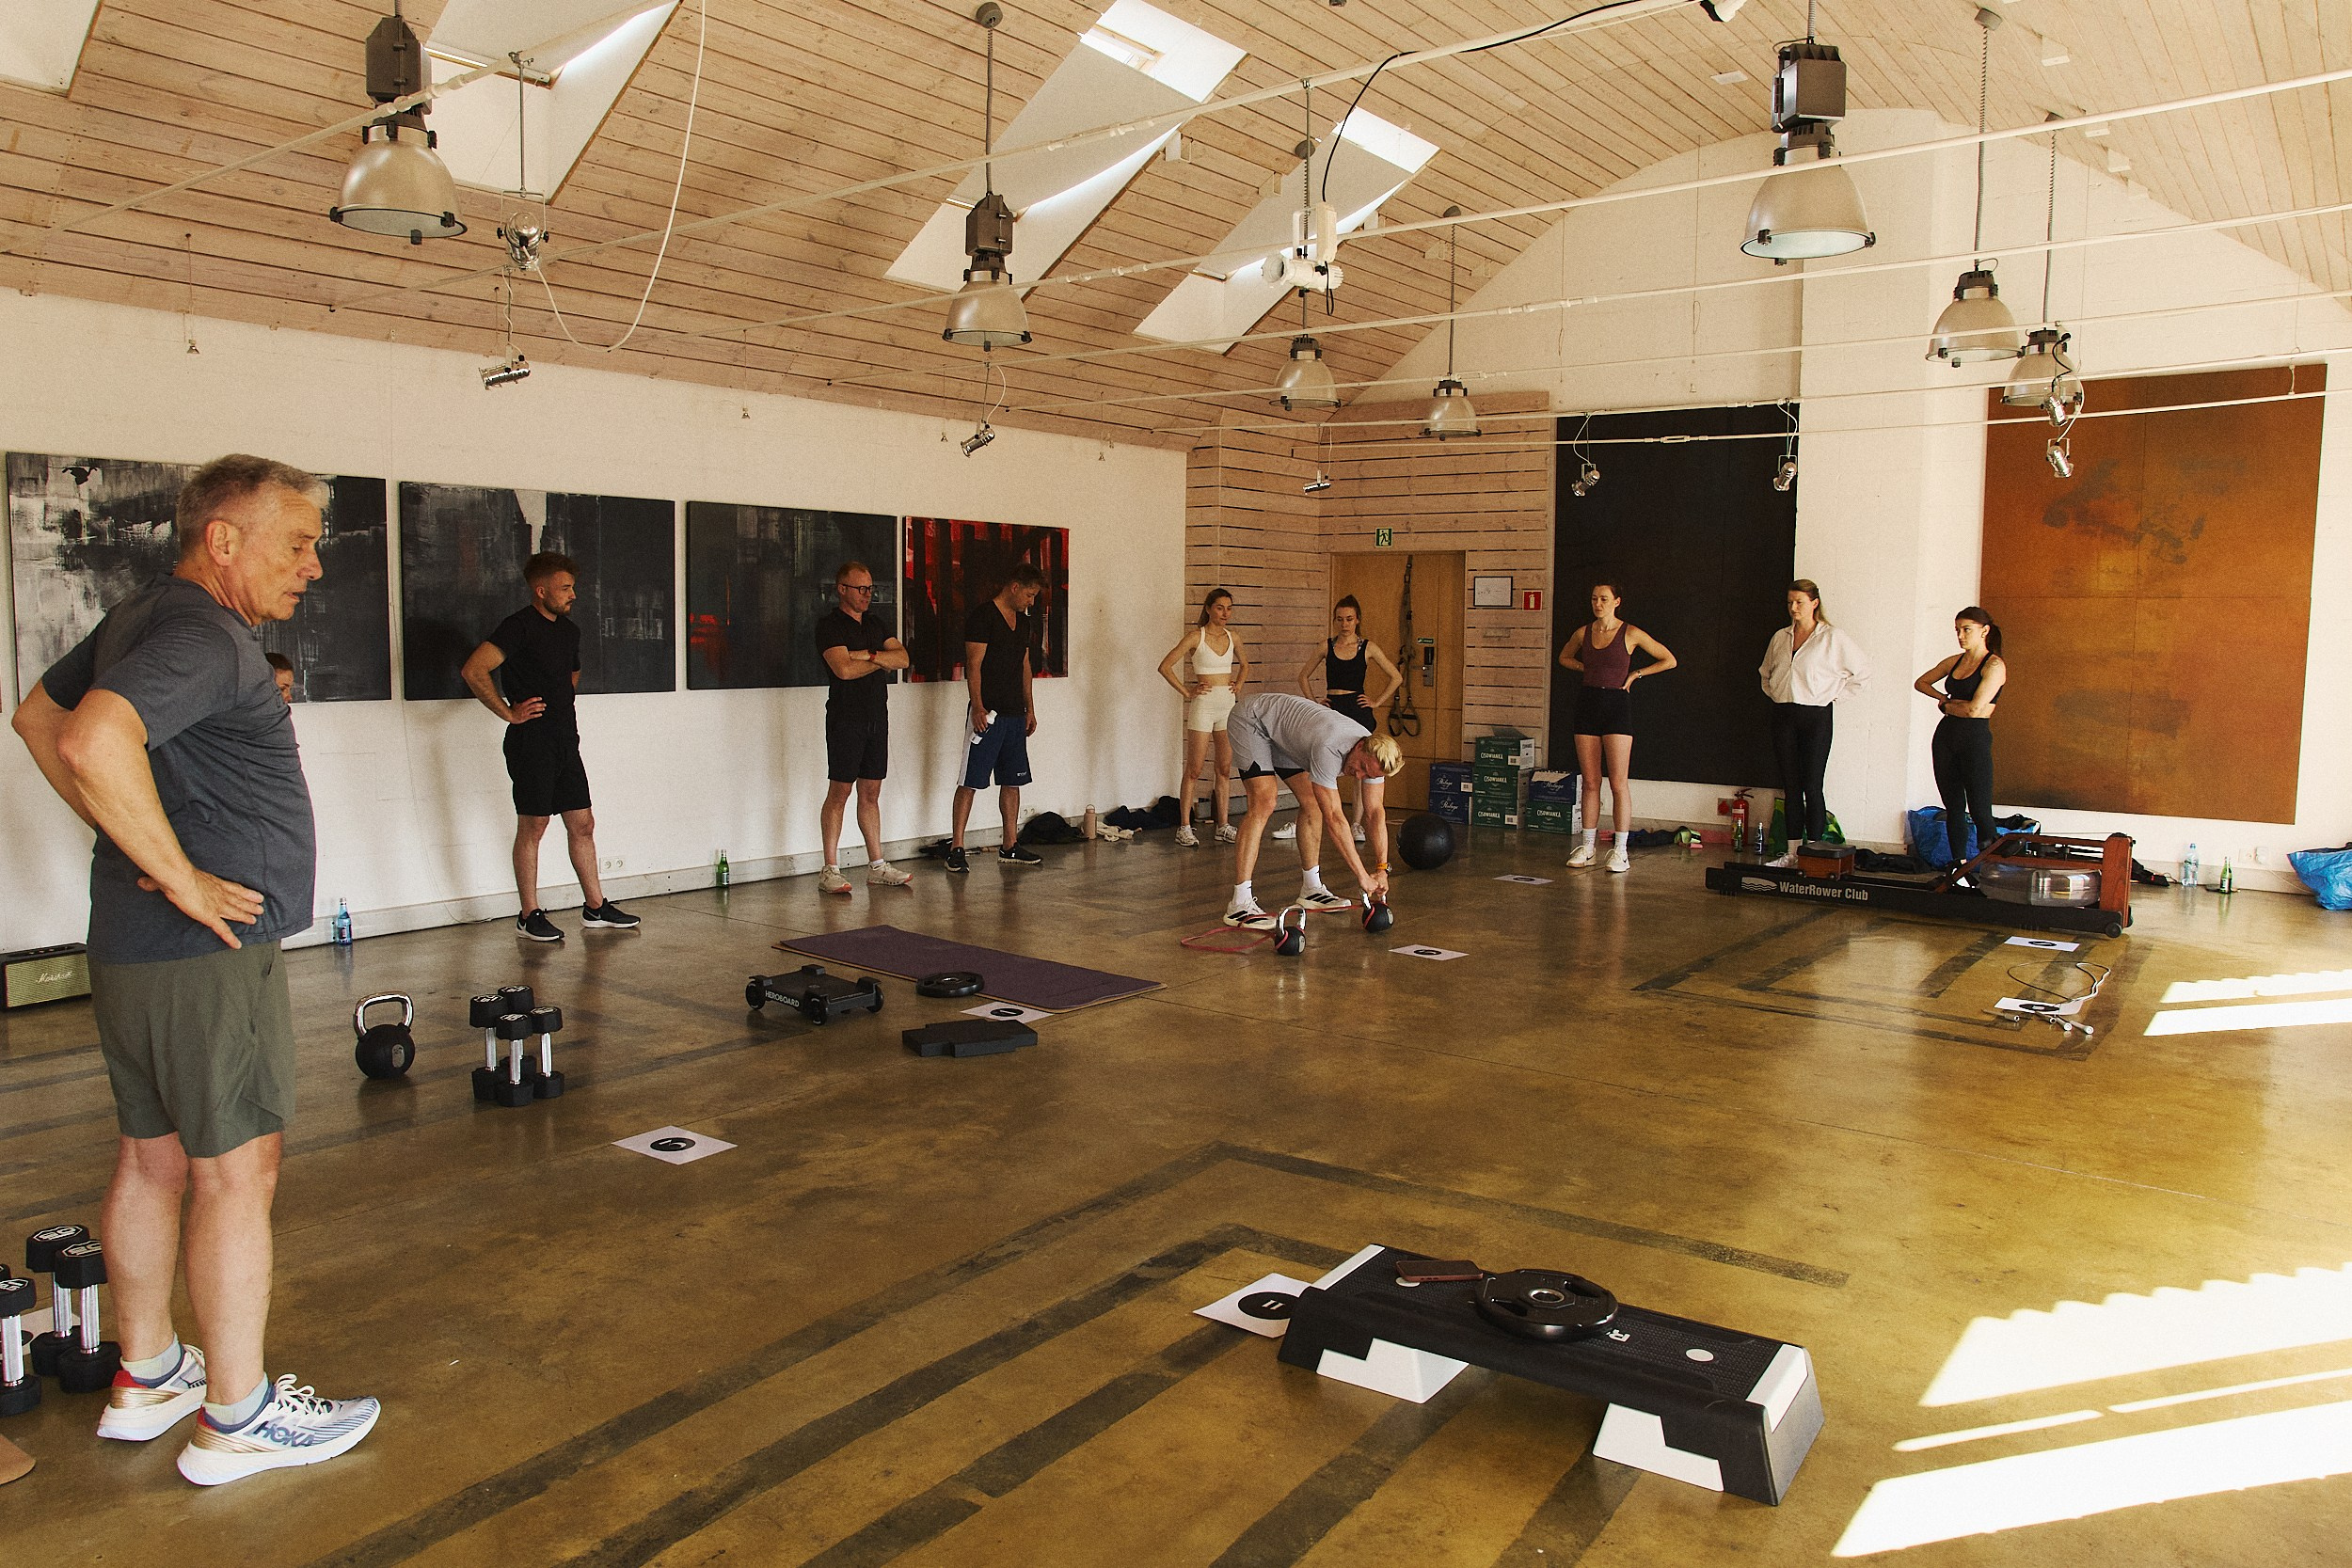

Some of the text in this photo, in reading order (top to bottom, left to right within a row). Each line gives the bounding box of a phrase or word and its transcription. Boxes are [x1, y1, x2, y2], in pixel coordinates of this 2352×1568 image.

[1480, 752, 1504, 760] CISOWIANKA
[1484, 775, 1507, 784] CISOWIANKA
[1478, 811, 1501, 819] CISOWIANKA
[1536, 809, 1562, 818] CISOWIANKA
[1779, 881, 1868, 901] WaterRower Club
[765, 990, 800, 1007] HEROBOARD
[252, 1420, 315, 1448] HOKA
